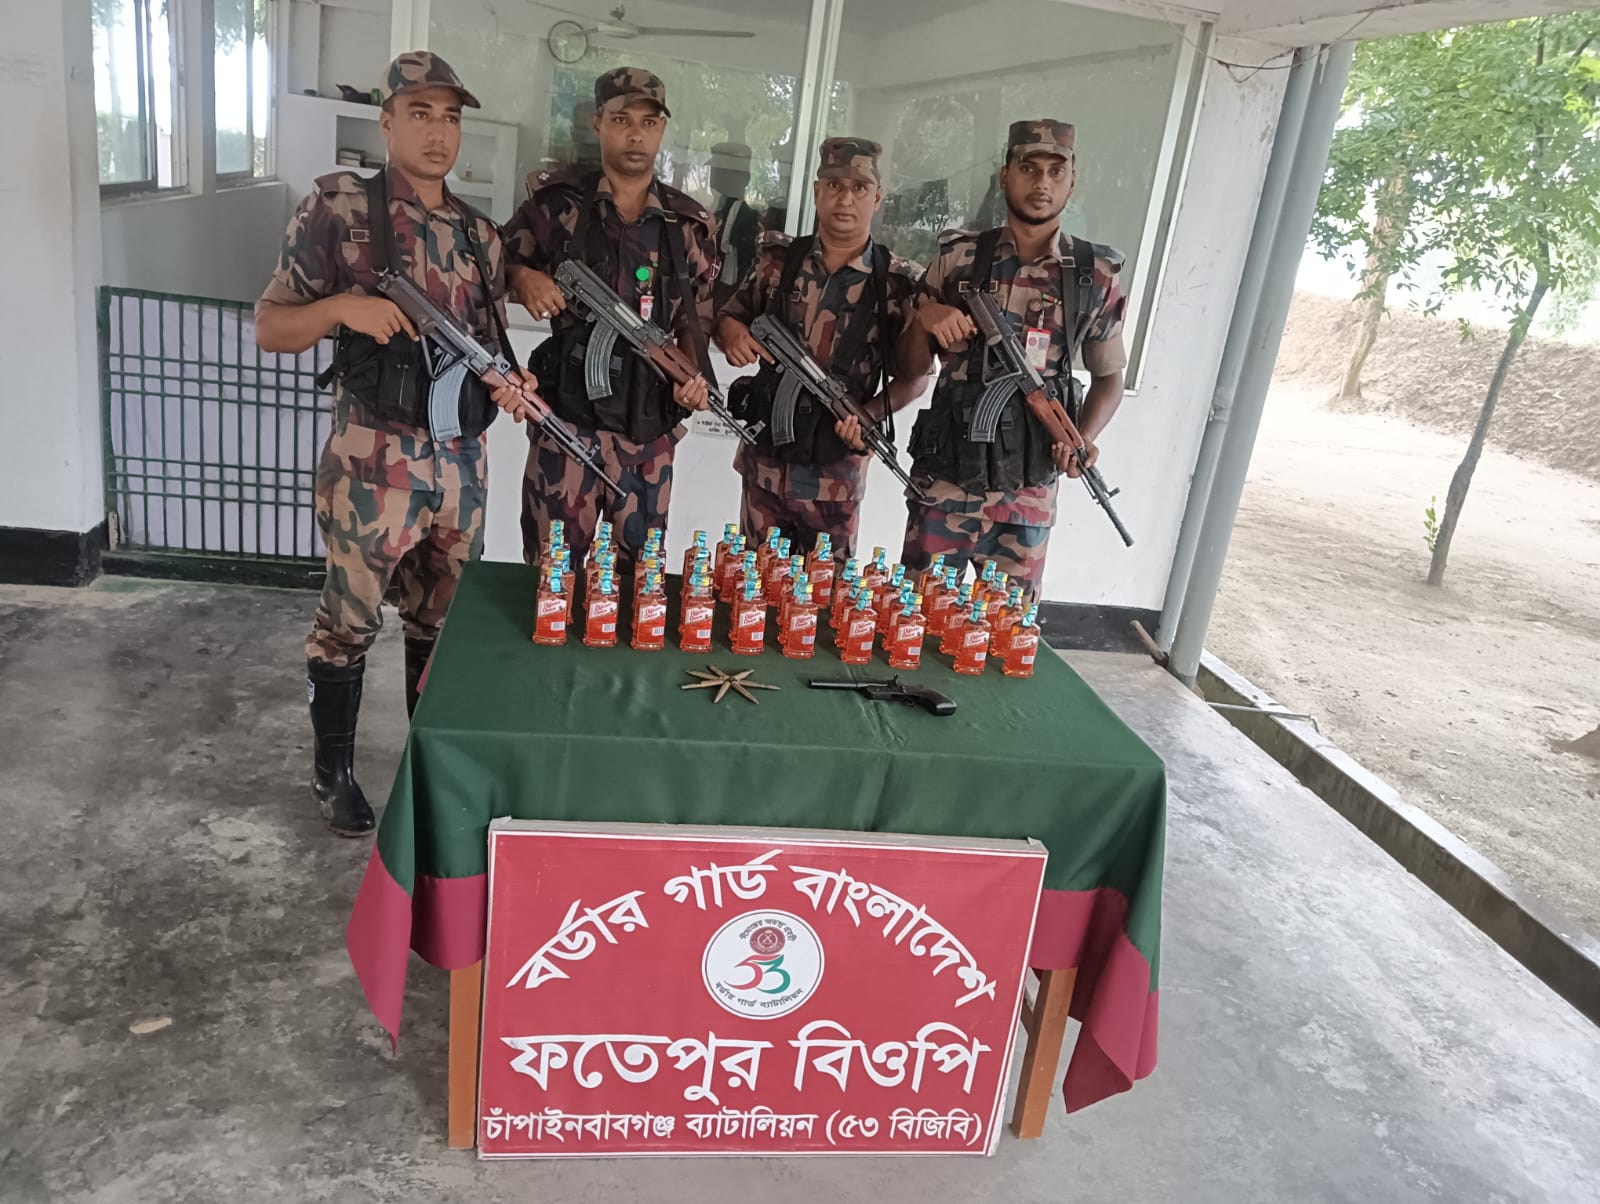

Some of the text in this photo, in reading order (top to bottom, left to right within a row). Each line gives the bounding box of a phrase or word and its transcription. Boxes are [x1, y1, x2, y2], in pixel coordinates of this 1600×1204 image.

[505, 848, 996, 1008] বর্ডার গার্ড বাংলাদেশ
[500, 1019, 993, 1106] ফতেপুর বিওপি
[482, 1105, 983, 1147] চাঁপাইনবাবগঞ্জ ব্যাটালিয়ন (৫৩ বিজিবি)
